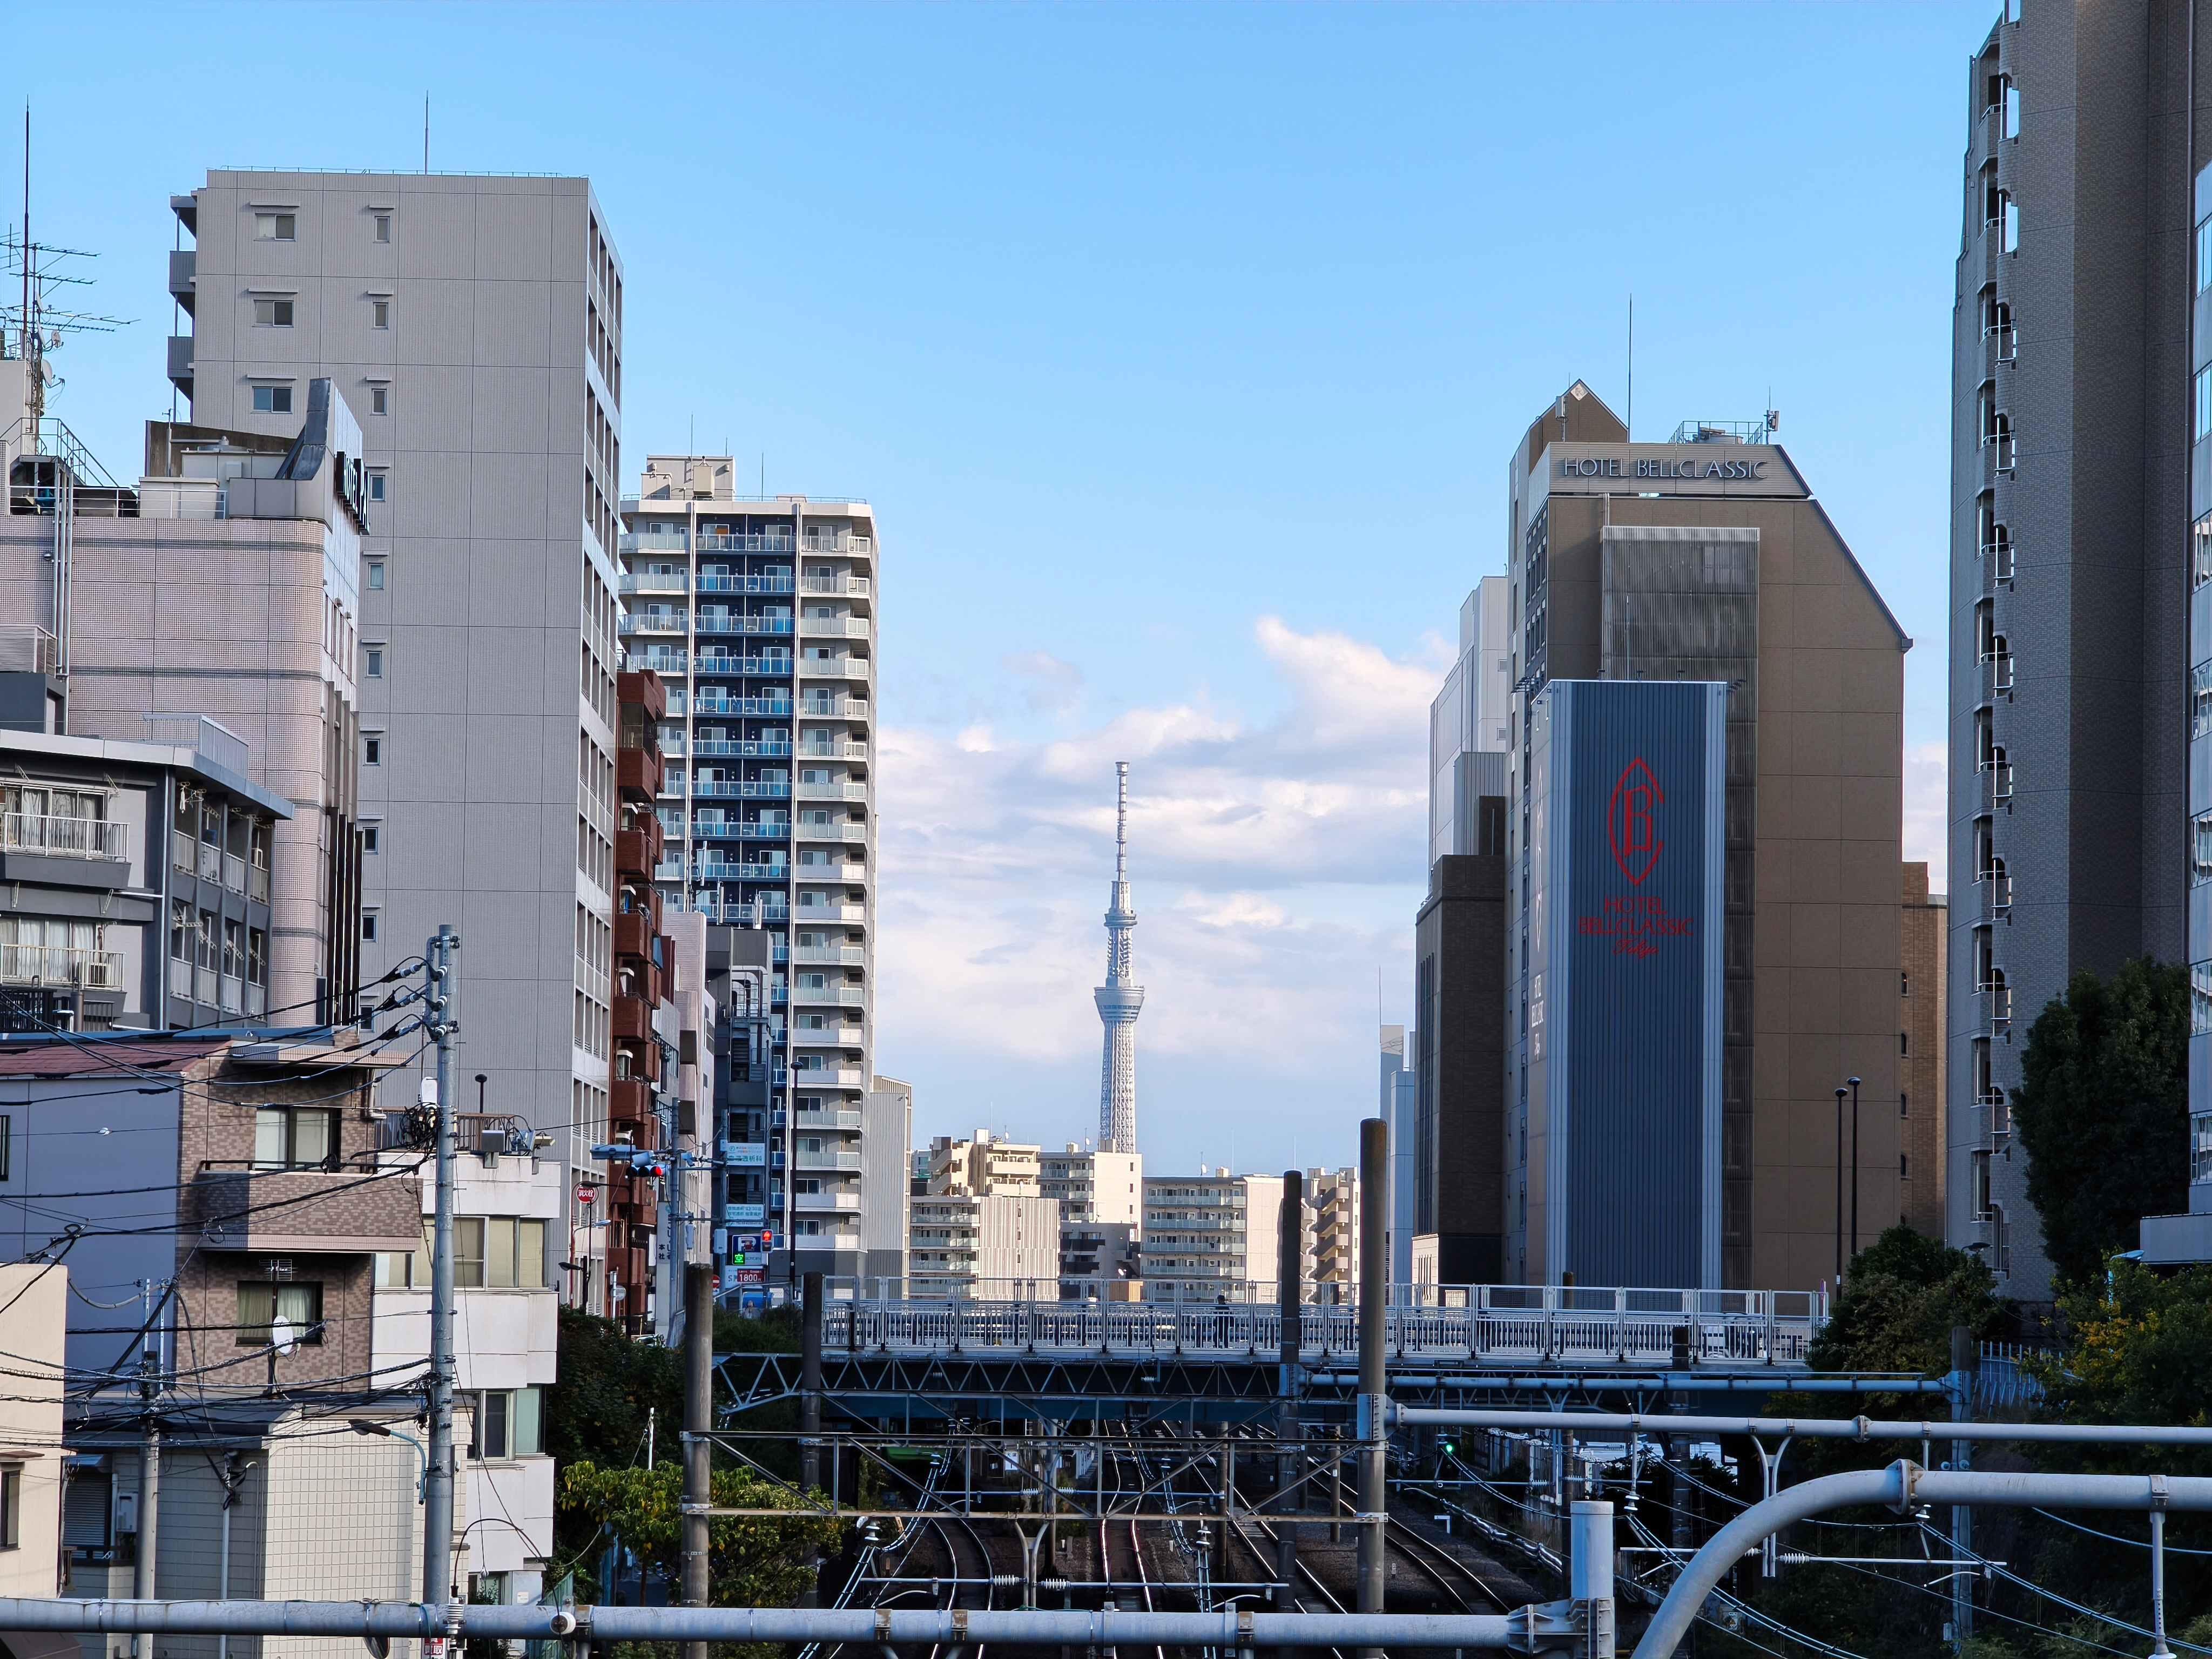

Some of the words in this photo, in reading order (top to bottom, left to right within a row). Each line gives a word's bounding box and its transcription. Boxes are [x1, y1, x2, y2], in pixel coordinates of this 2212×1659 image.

[1564, 457, 1630, 477] HOTEL
[1636, 458, 1768, 479] BELLCLASSIC
[343, 453, 358, 515] HOTEL
[1604, 895, 1667, 915] HOTEL
[1579, 916, 1694, 936] BELLCLASSIC
[659, 1244, 665, 1260] 本社
